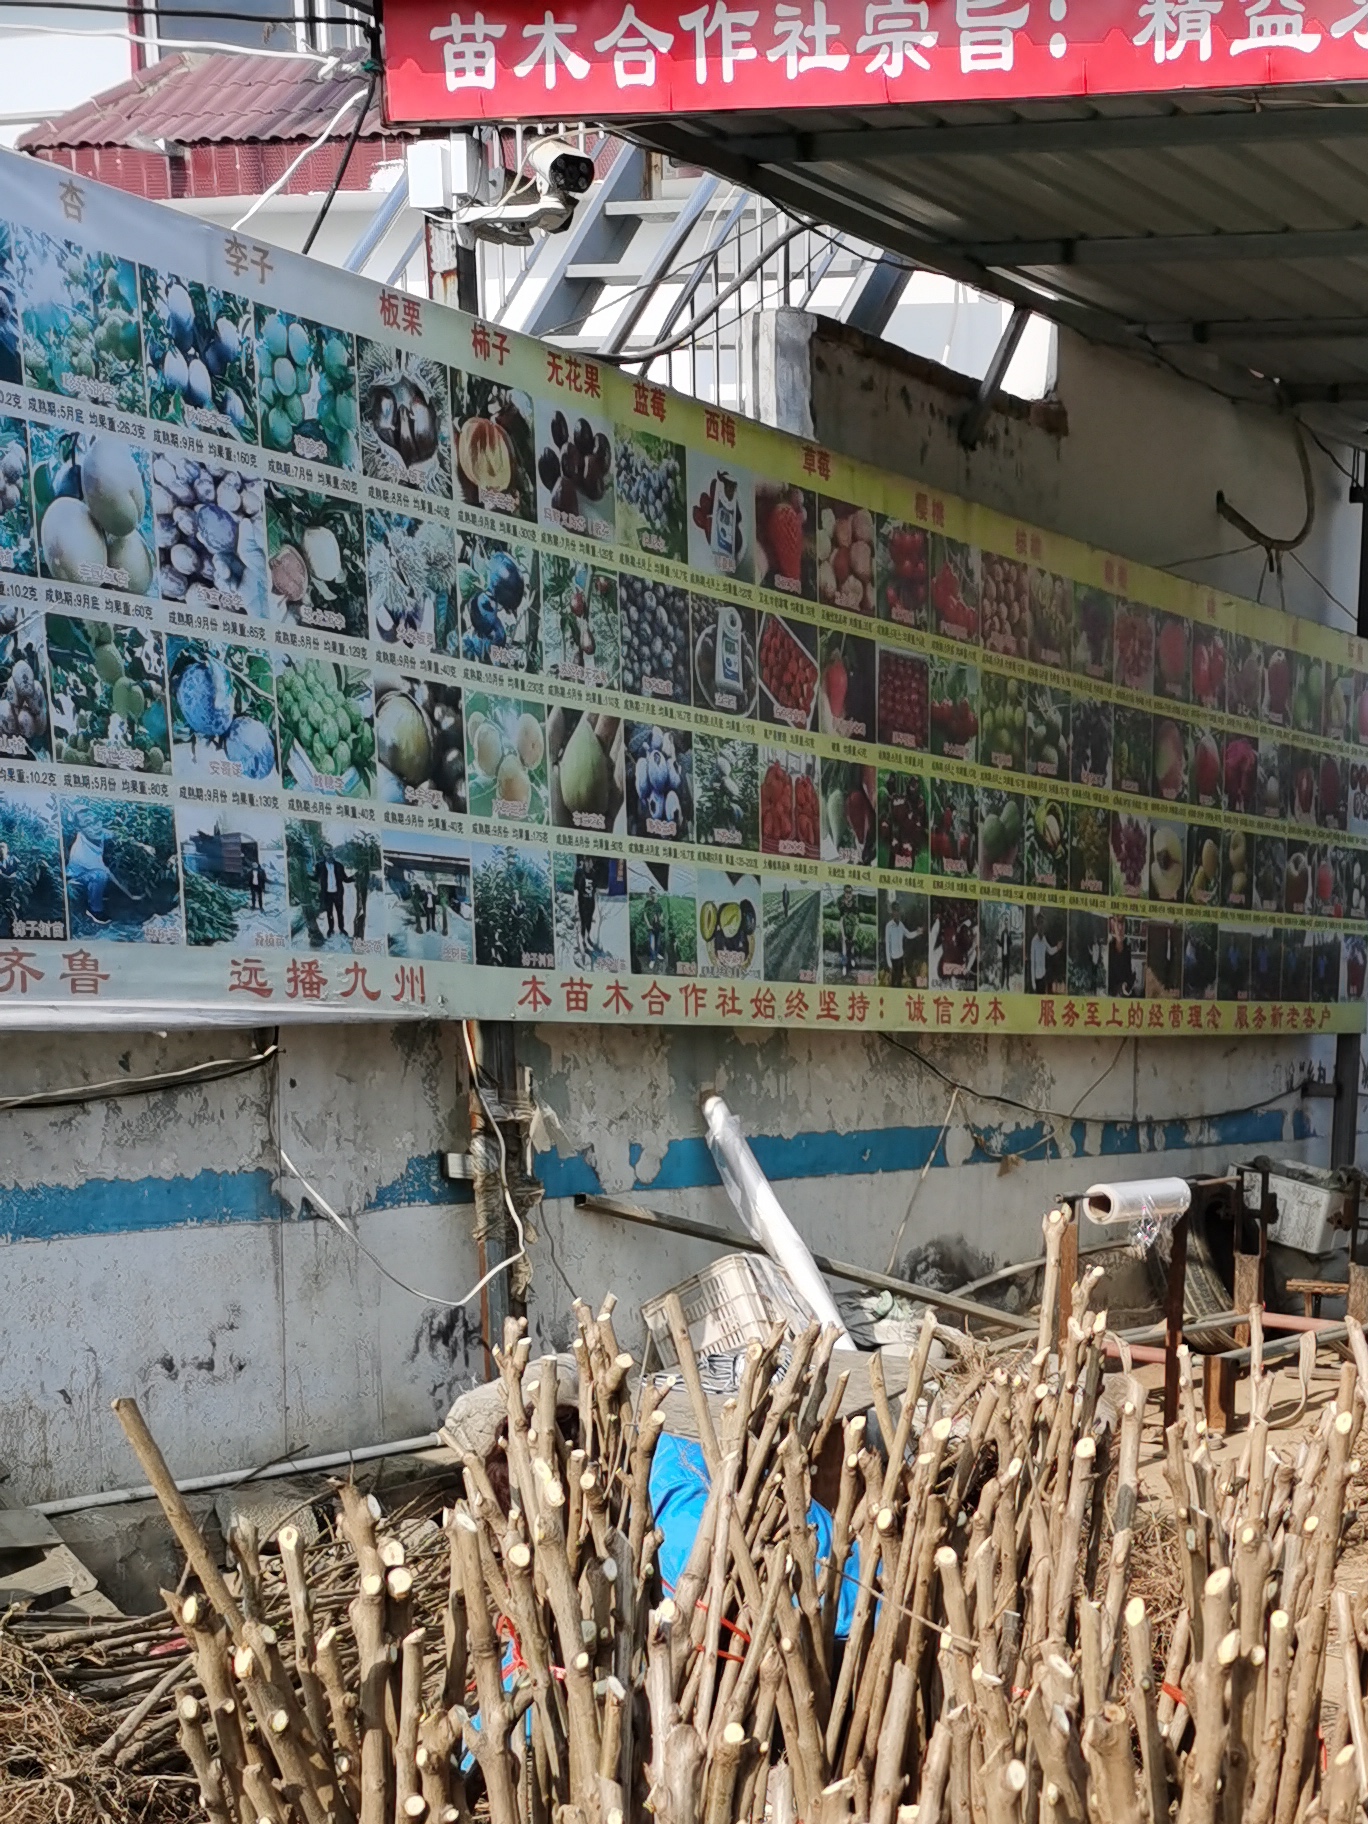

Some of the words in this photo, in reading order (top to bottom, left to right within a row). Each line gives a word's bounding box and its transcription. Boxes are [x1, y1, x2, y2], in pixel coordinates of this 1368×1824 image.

[59, 179, 85, 223] 杏
[225, 236, 273, 284] 李子
[380, 289, 423, 336] 板栗
[471, 323, 510, 366] 柿子
[546, 351, 601, 399] 无花果
[633, 383, 666, 424] 蓝莓
[705, 410, 736, 447] 西梅
[801, 446, 830, 481] 草莓
[0, 947, 111, 994] 齐鲁
[228, 957, 425, 1003] 远播九州
[1037, 1001, 1222, 1030] 服务至上的经营理念
[1235, 1002, 1332, 1030] 服务新老客户
